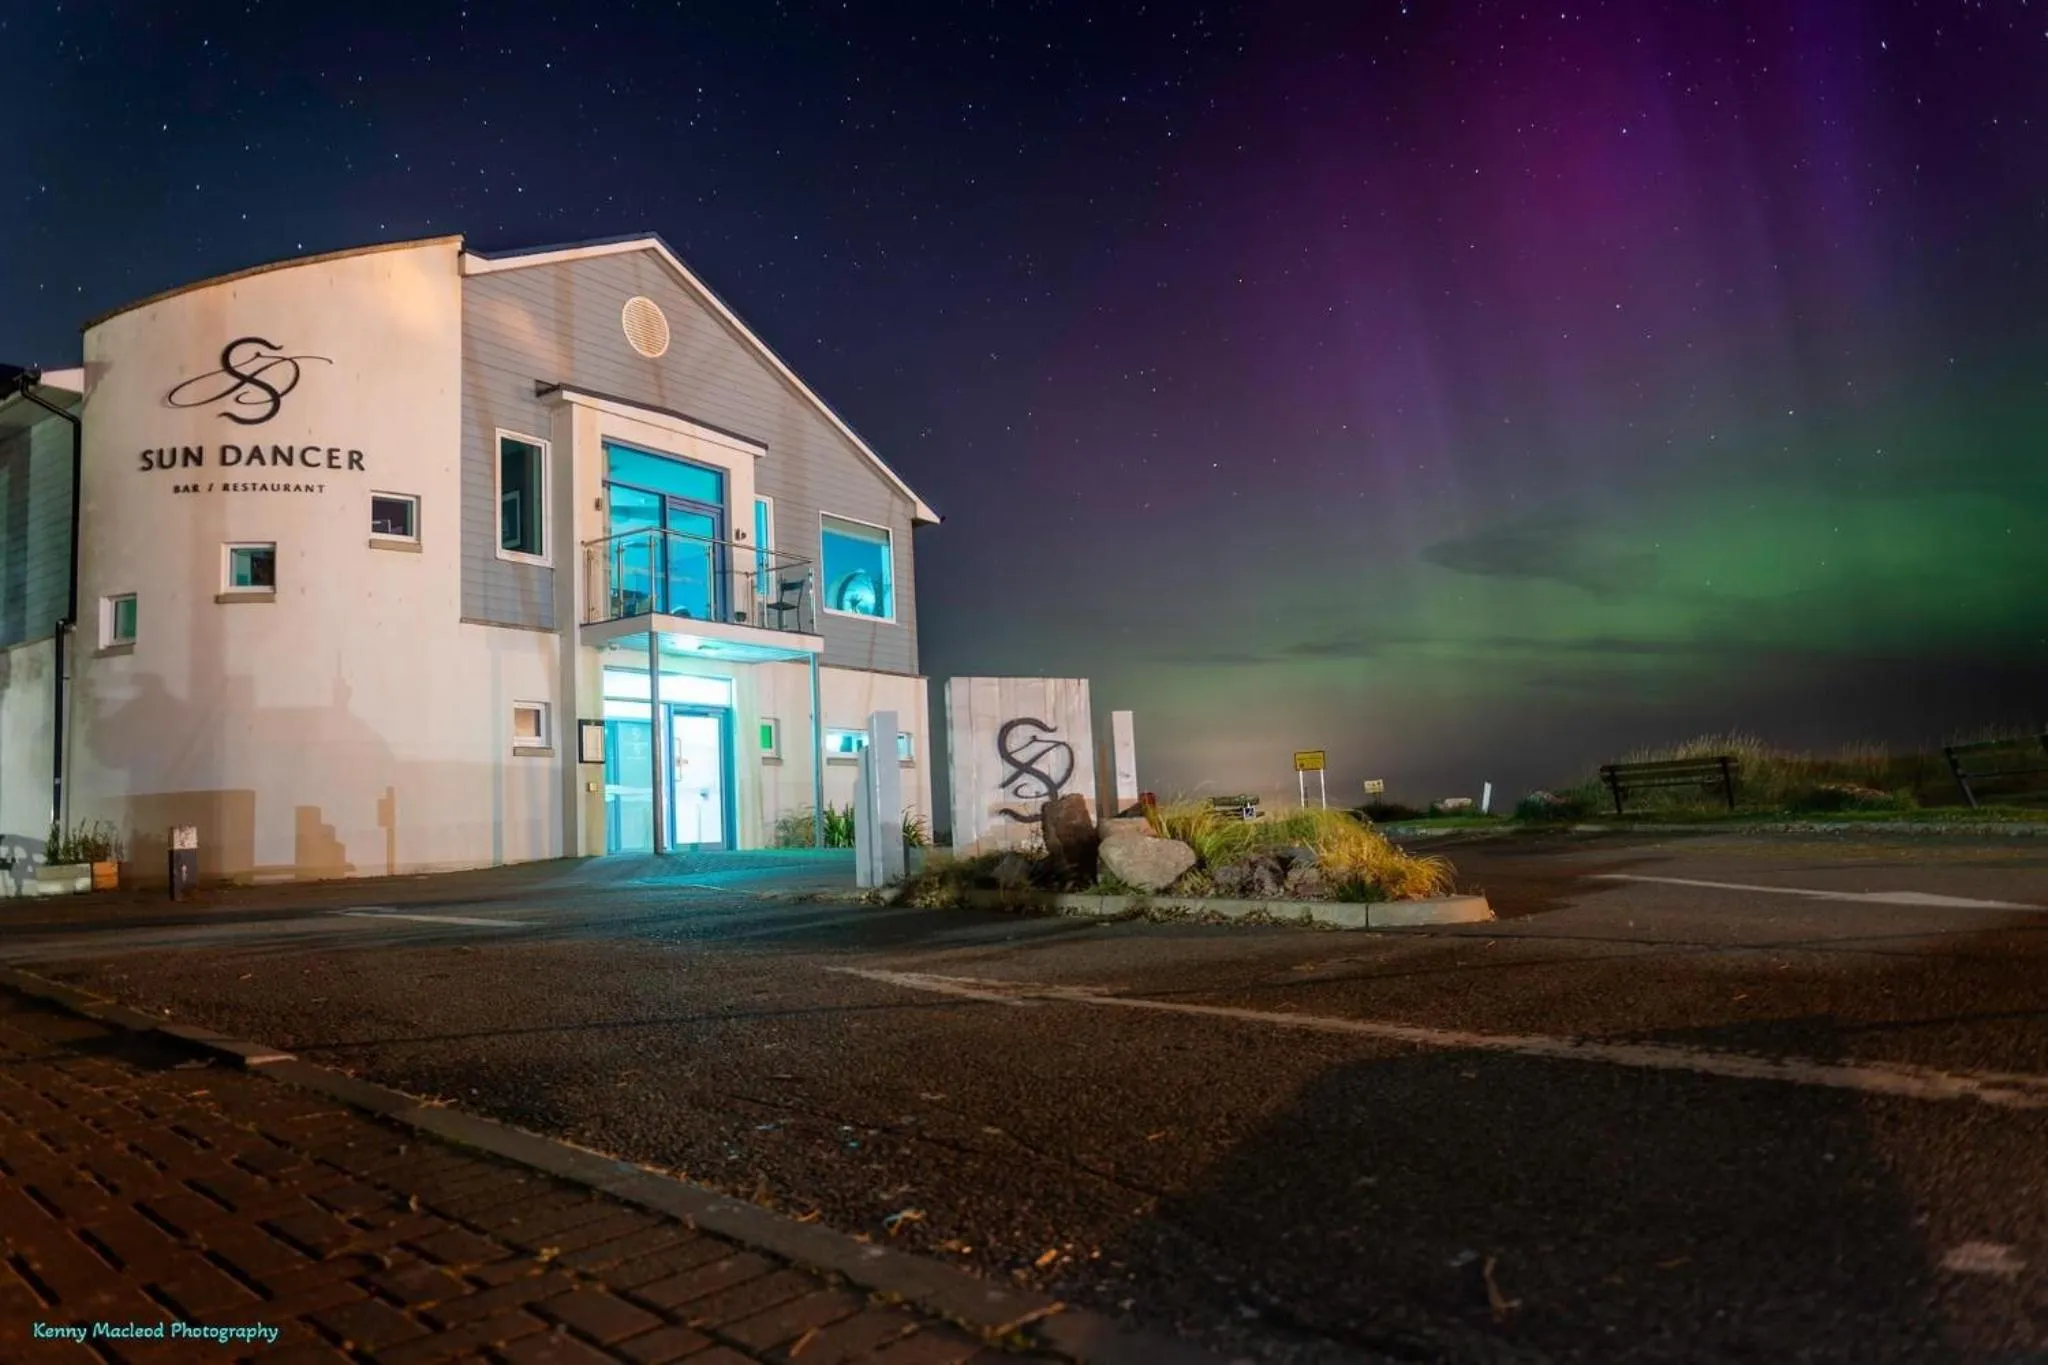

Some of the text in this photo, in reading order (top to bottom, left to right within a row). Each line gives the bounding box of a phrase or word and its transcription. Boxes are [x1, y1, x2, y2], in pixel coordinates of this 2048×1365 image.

[139, 444, 366, 472] SUN DANCER
[173, 484, 200, 494] BAR
[222, 482, 326, 494] RESTAURANT
